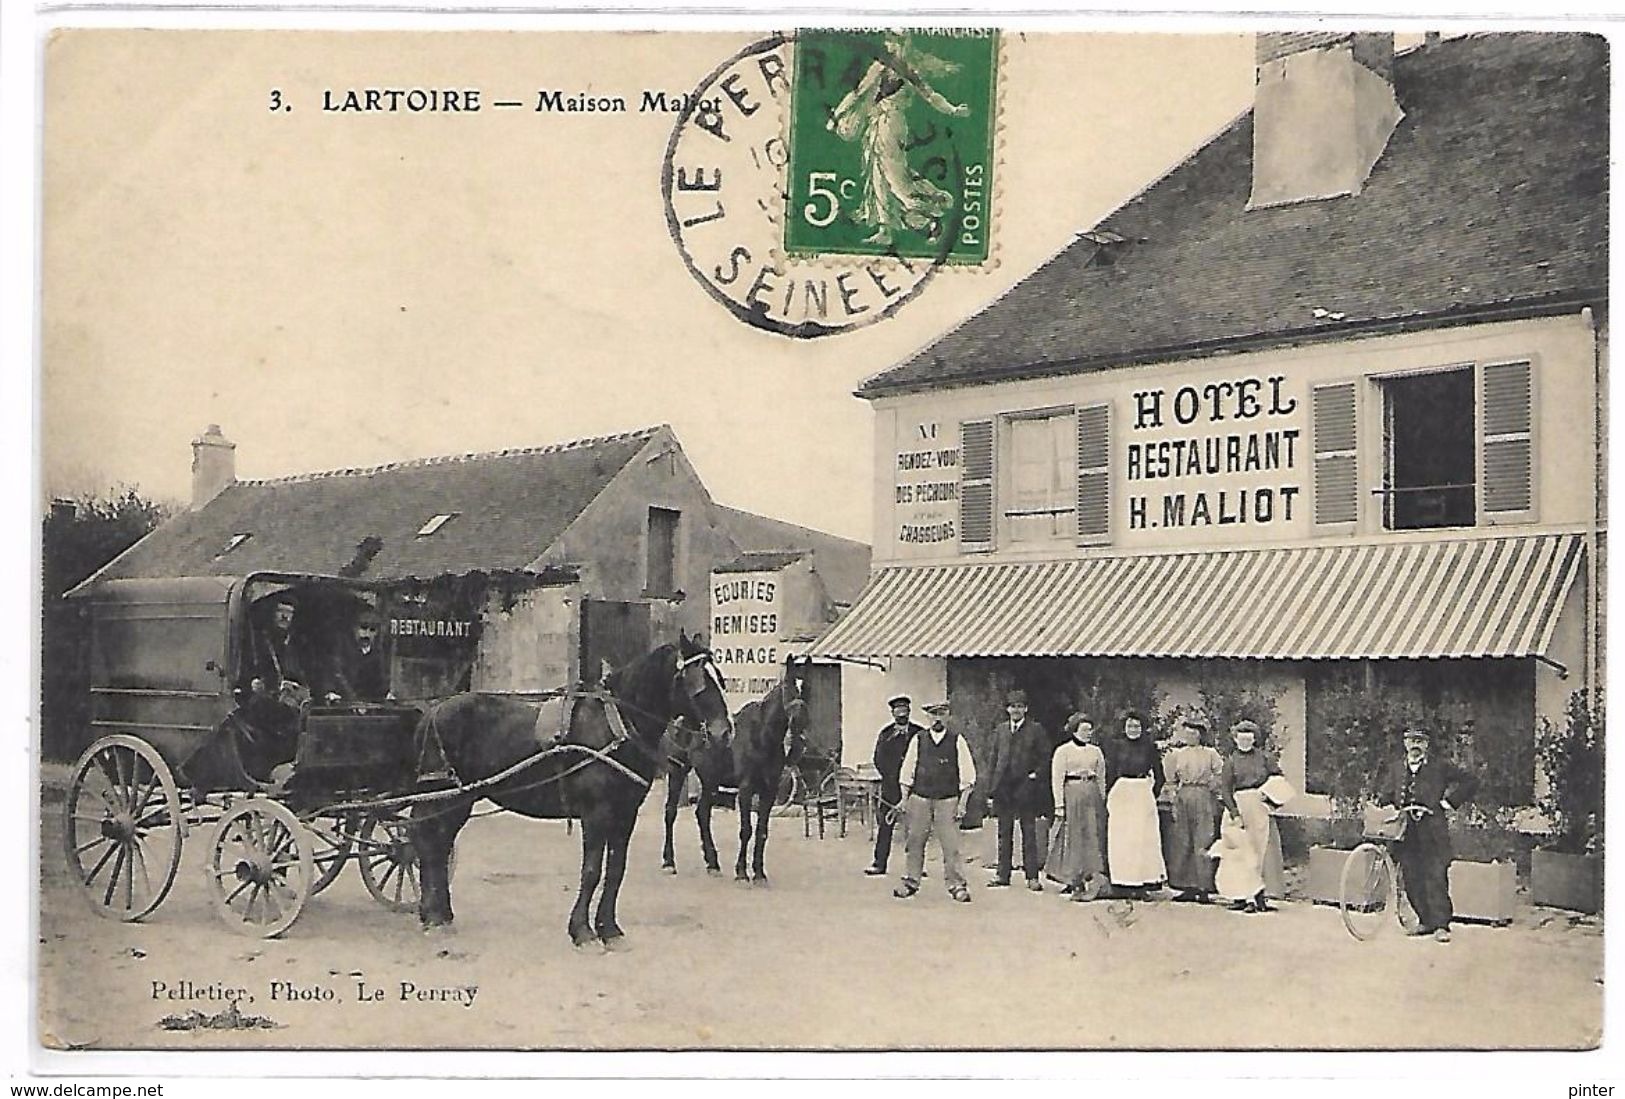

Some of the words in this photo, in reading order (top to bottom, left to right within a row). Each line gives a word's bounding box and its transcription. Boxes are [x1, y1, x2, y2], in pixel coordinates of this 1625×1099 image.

[677, 166, 726, 228] LE
[961, 163, 985, 245] POSTES
[714, 246, 870, 316] SEINE
[1133, 376, 1297, 430] HOTEL
[1128, 429, 1301, 480] RESTAURANT
[896, 485, 913, 503] DES
[899, 520, 956, 543] CHASSEURS
[390, 618, 472, 638] RESTAURANT
[714, 613, 777, 635] REMISES
[714, 647, 777, 664] GARAGE
